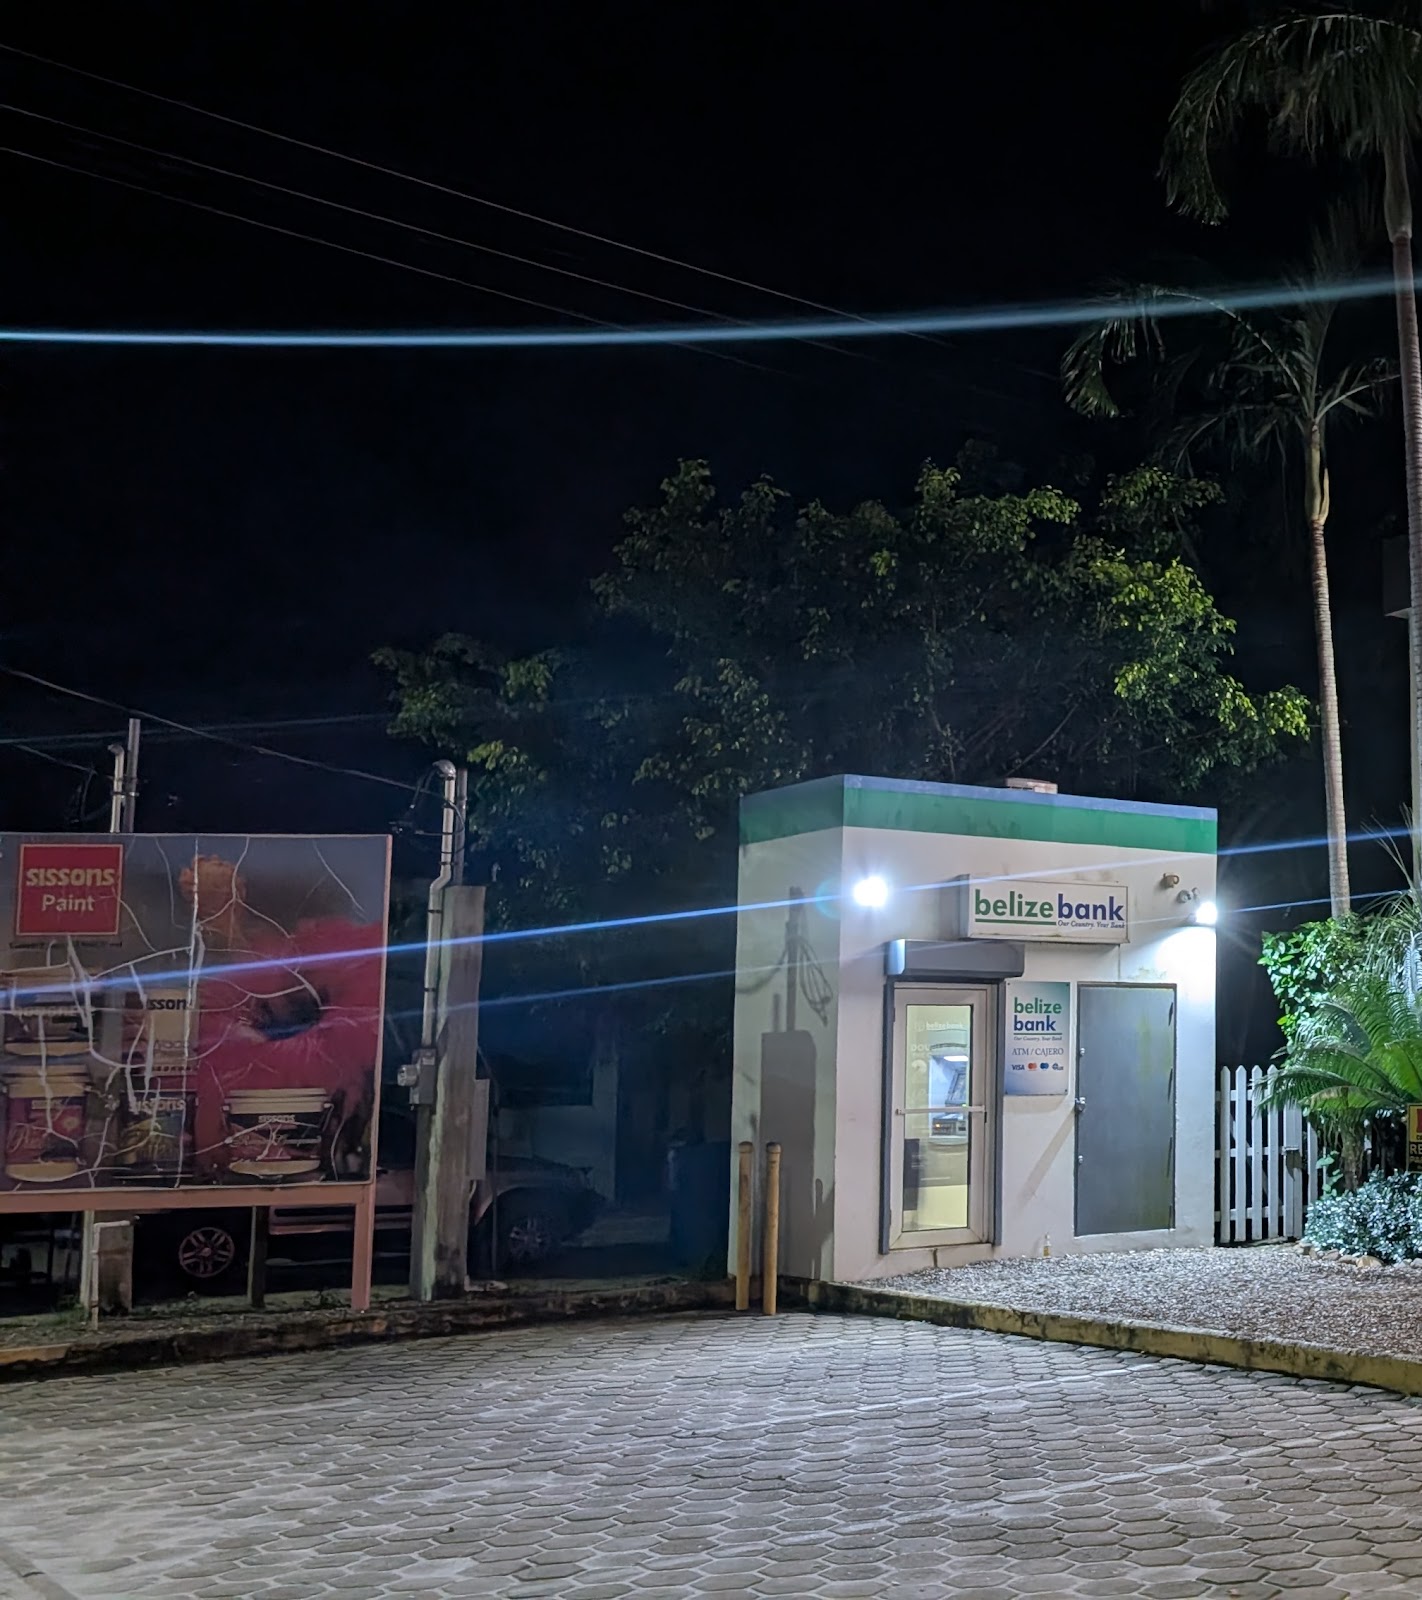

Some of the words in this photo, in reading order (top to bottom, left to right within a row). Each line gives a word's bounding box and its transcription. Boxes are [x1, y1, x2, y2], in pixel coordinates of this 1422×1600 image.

[26, 868, 115, 886] sissons
[41, 894, 96, 911] Paint
[975, 889, 1054, 918] belize
[1057, 893, 1125, 921] bank
[1014, 996, 1062, 1014] belize
[1013, 1014, 1056, 1031] bank
[1012, 1048, 1029, 1056] ATM
[1030, 1048, 1035, 1056] /
[1035, 1048, 1064, 1057] CAJERO
